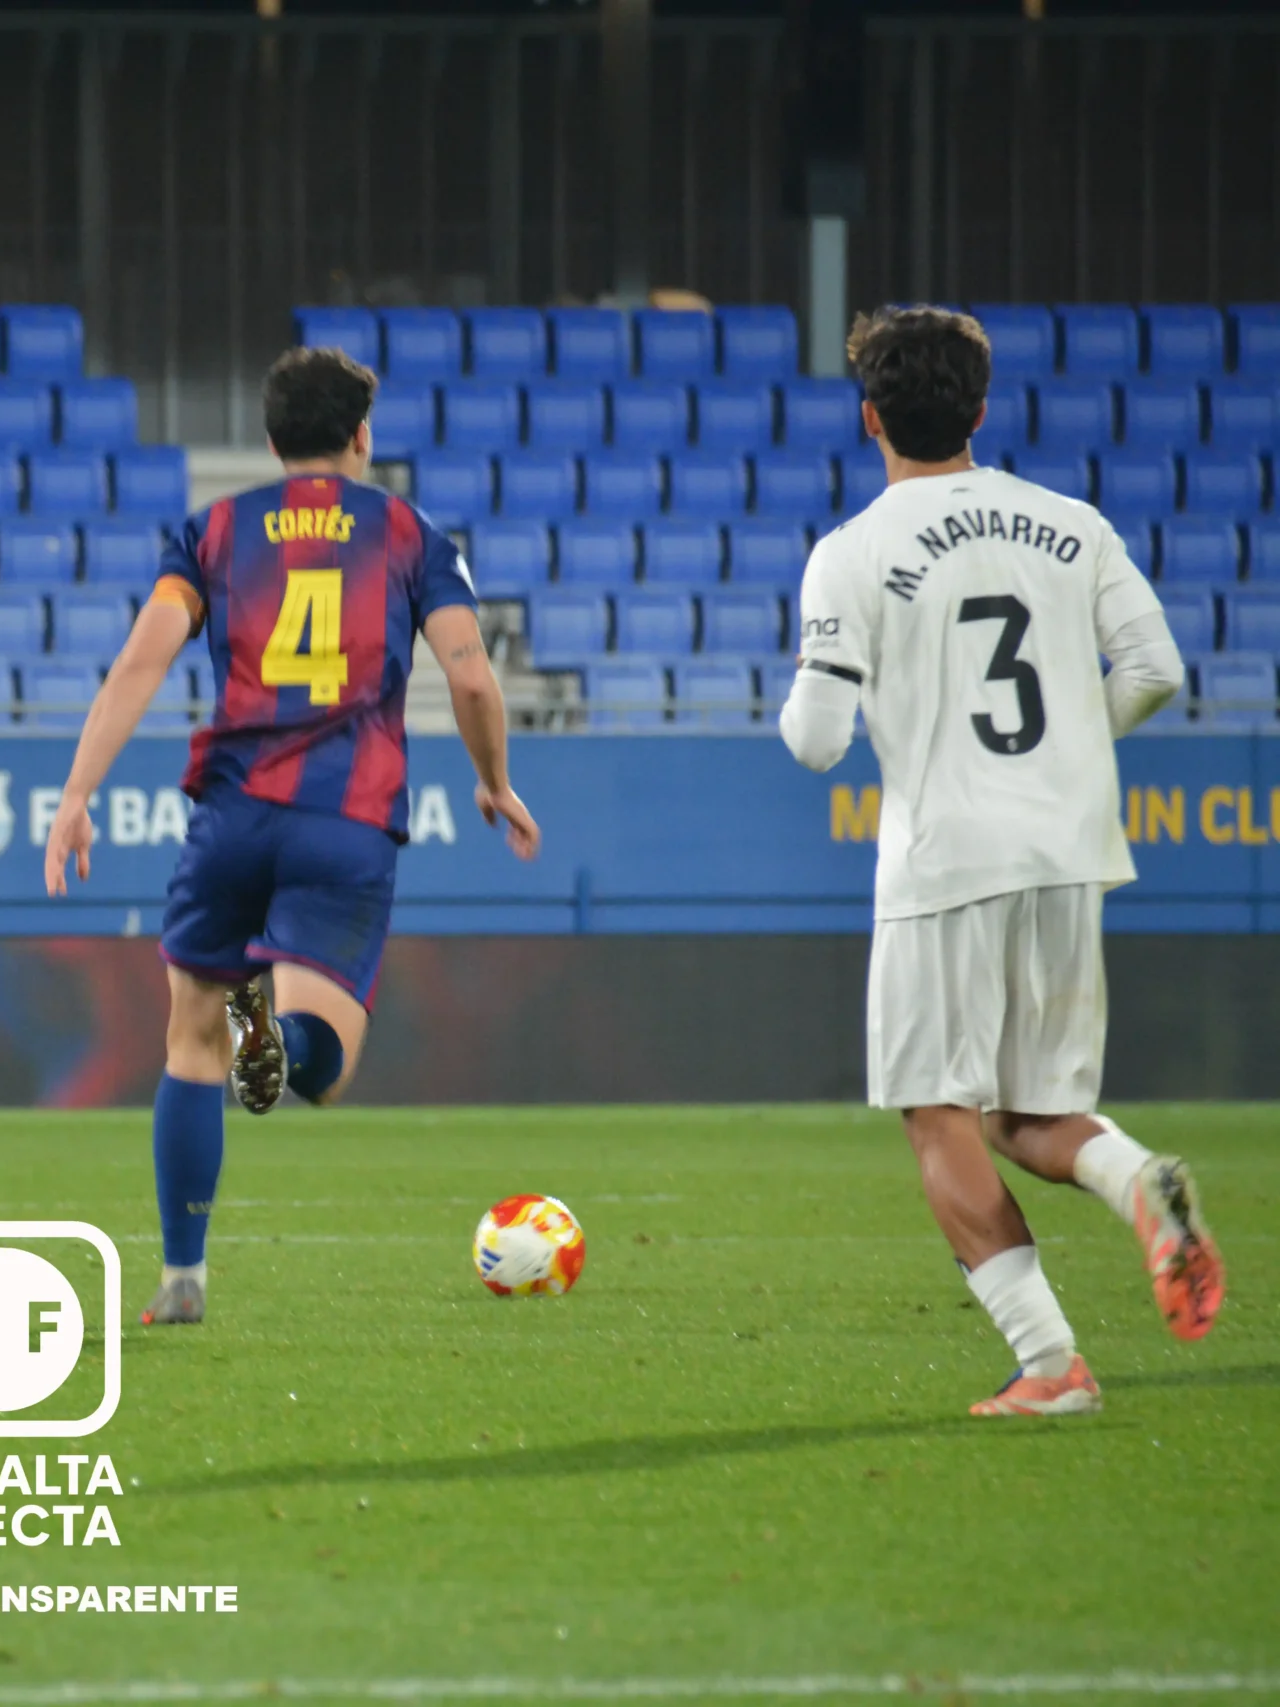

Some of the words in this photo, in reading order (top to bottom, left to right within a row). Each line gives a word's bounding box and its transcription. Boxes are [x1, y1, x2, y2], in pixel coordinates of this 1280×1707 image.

[263, 504, 356, 544] CORTÉS
[884, 564, 928, 602] M.
[916, 509, 1081, 565] NAVARRO
[261, 568, 348, 705] 4
[957, 594, 1046, 756] 3
[1200, 784, 1280, 845] CL
